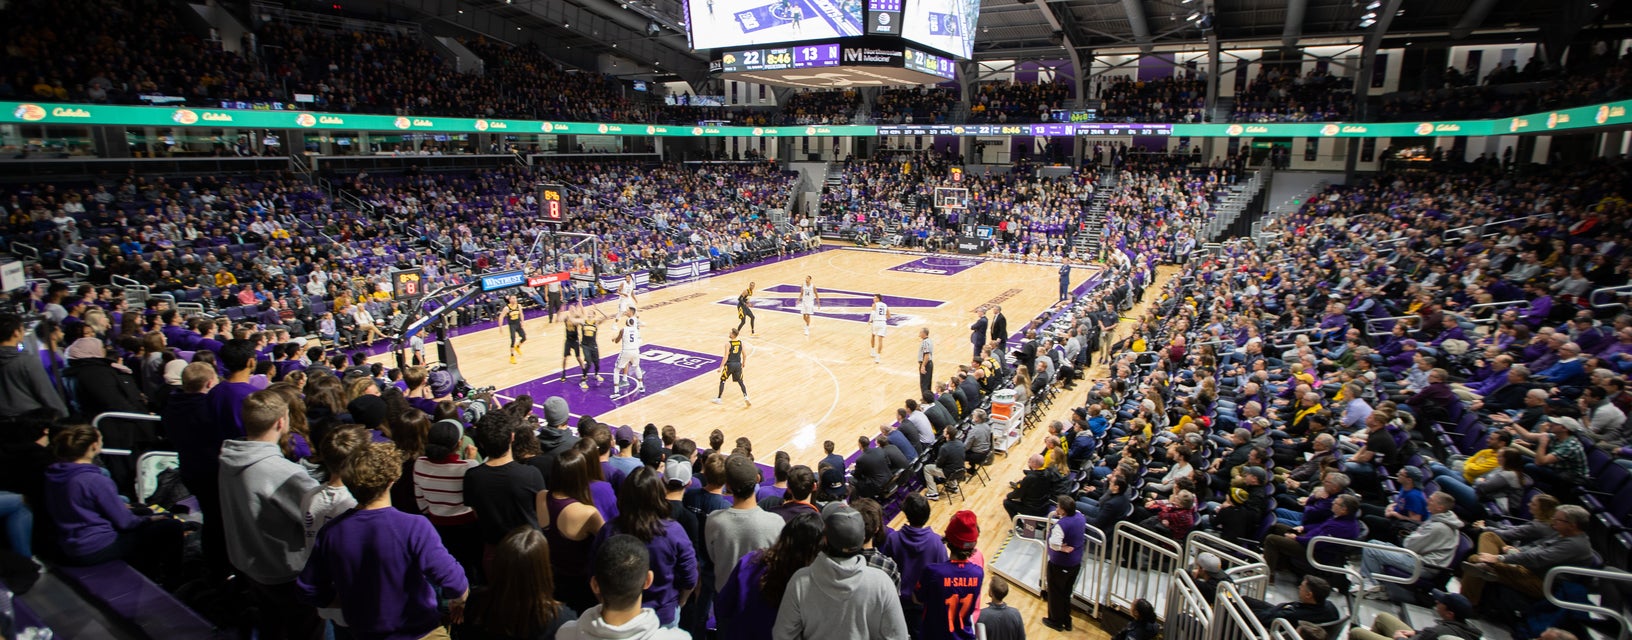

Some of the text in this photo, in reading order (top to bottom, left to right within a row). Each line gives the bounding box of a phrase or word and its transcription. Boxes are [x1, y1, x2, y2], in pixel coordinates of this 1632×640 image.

[743, 51, 760, 65] 22
[802, 47, 818, 60] 13
[829, 46, 837, 59] N
[863, 48, 903, 57] Northwestern
[915, 51, 924, 65] 22
[766, 53, 791, 64] 8:46
[863, 55, 890, 63] Medicine
[979, 126, 990, 134] 22
[1002, 126, 1021, 134] 8:46
[1034, 126, 1045, 134] 13
[953, 173, 961, 181] 8
[550, 200, 559, 219] 8
[485, 275, 522, 288] WINTRUST
[407, 282, 415, 294] 8
[629, 334, 634, 343] 5
[944, 593, 974, 633] 11
